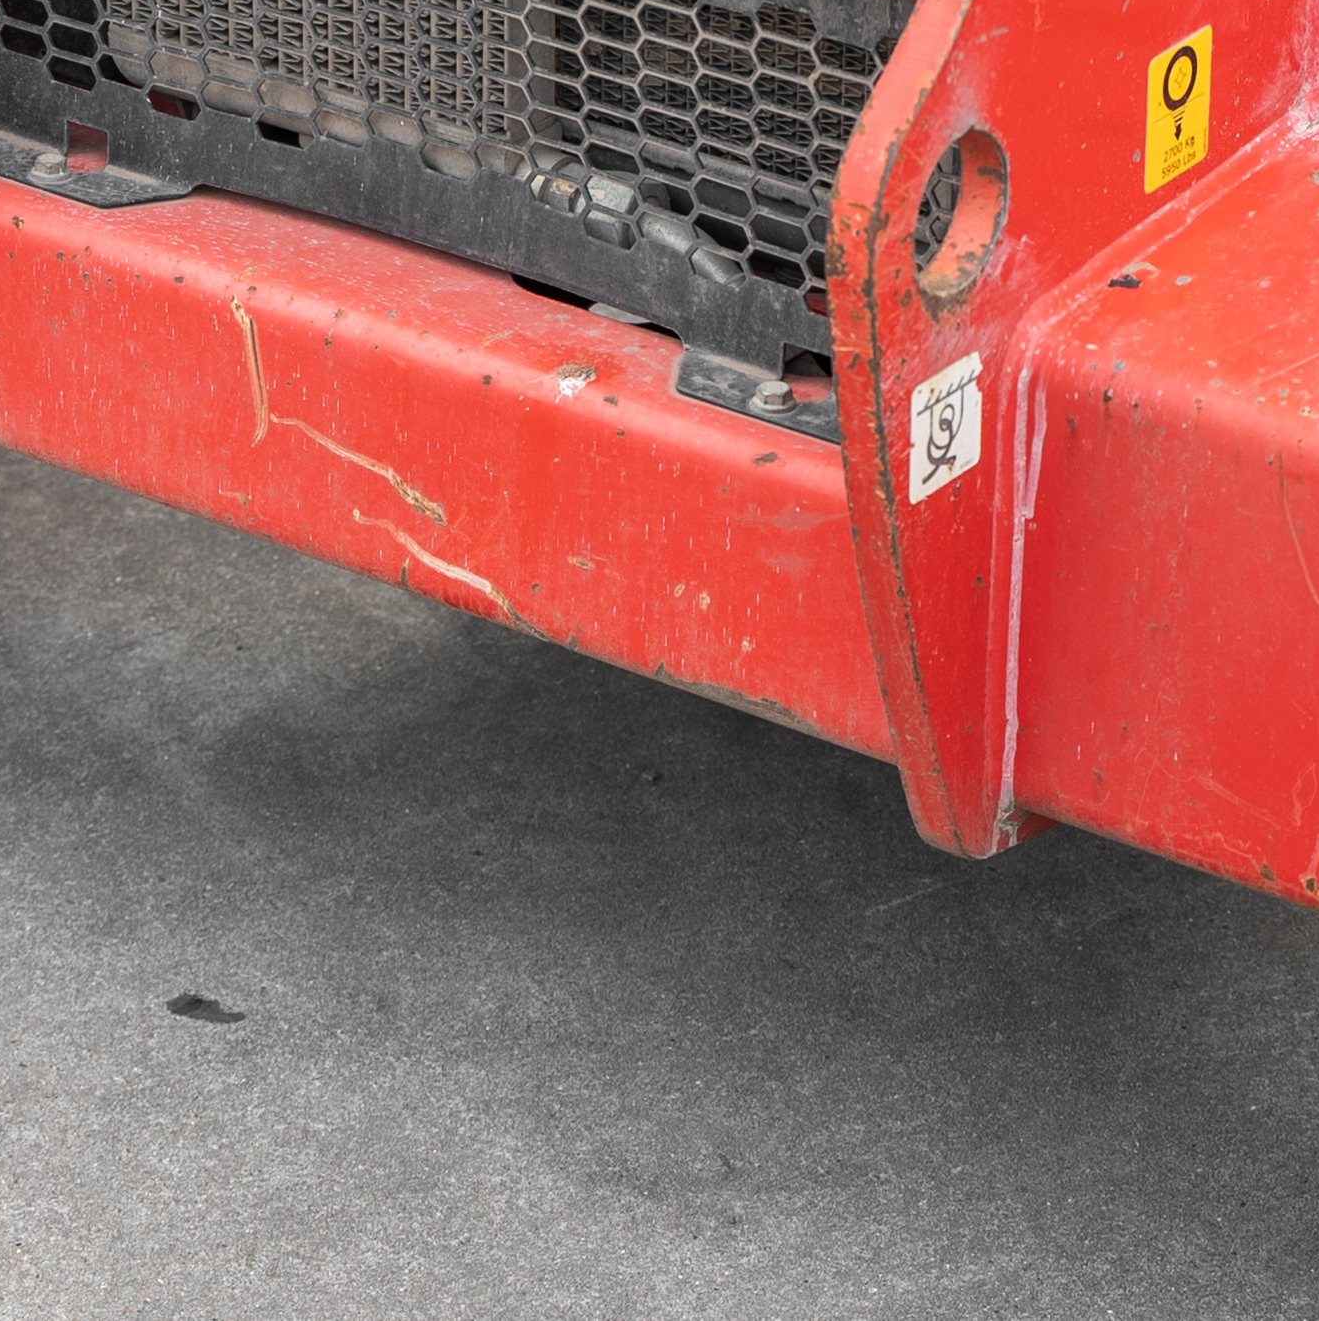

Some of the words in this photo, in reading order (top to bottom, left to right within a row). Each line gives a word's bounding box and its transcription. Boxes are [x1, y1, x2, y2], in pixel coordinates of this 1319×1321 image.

[1164, 142, 1183, 163] 2700
[1185, 136, 1195, 149] Kg
[1162, 159, 1181, 179] 5950
[1183, 150, 1196, 165] Lbs
